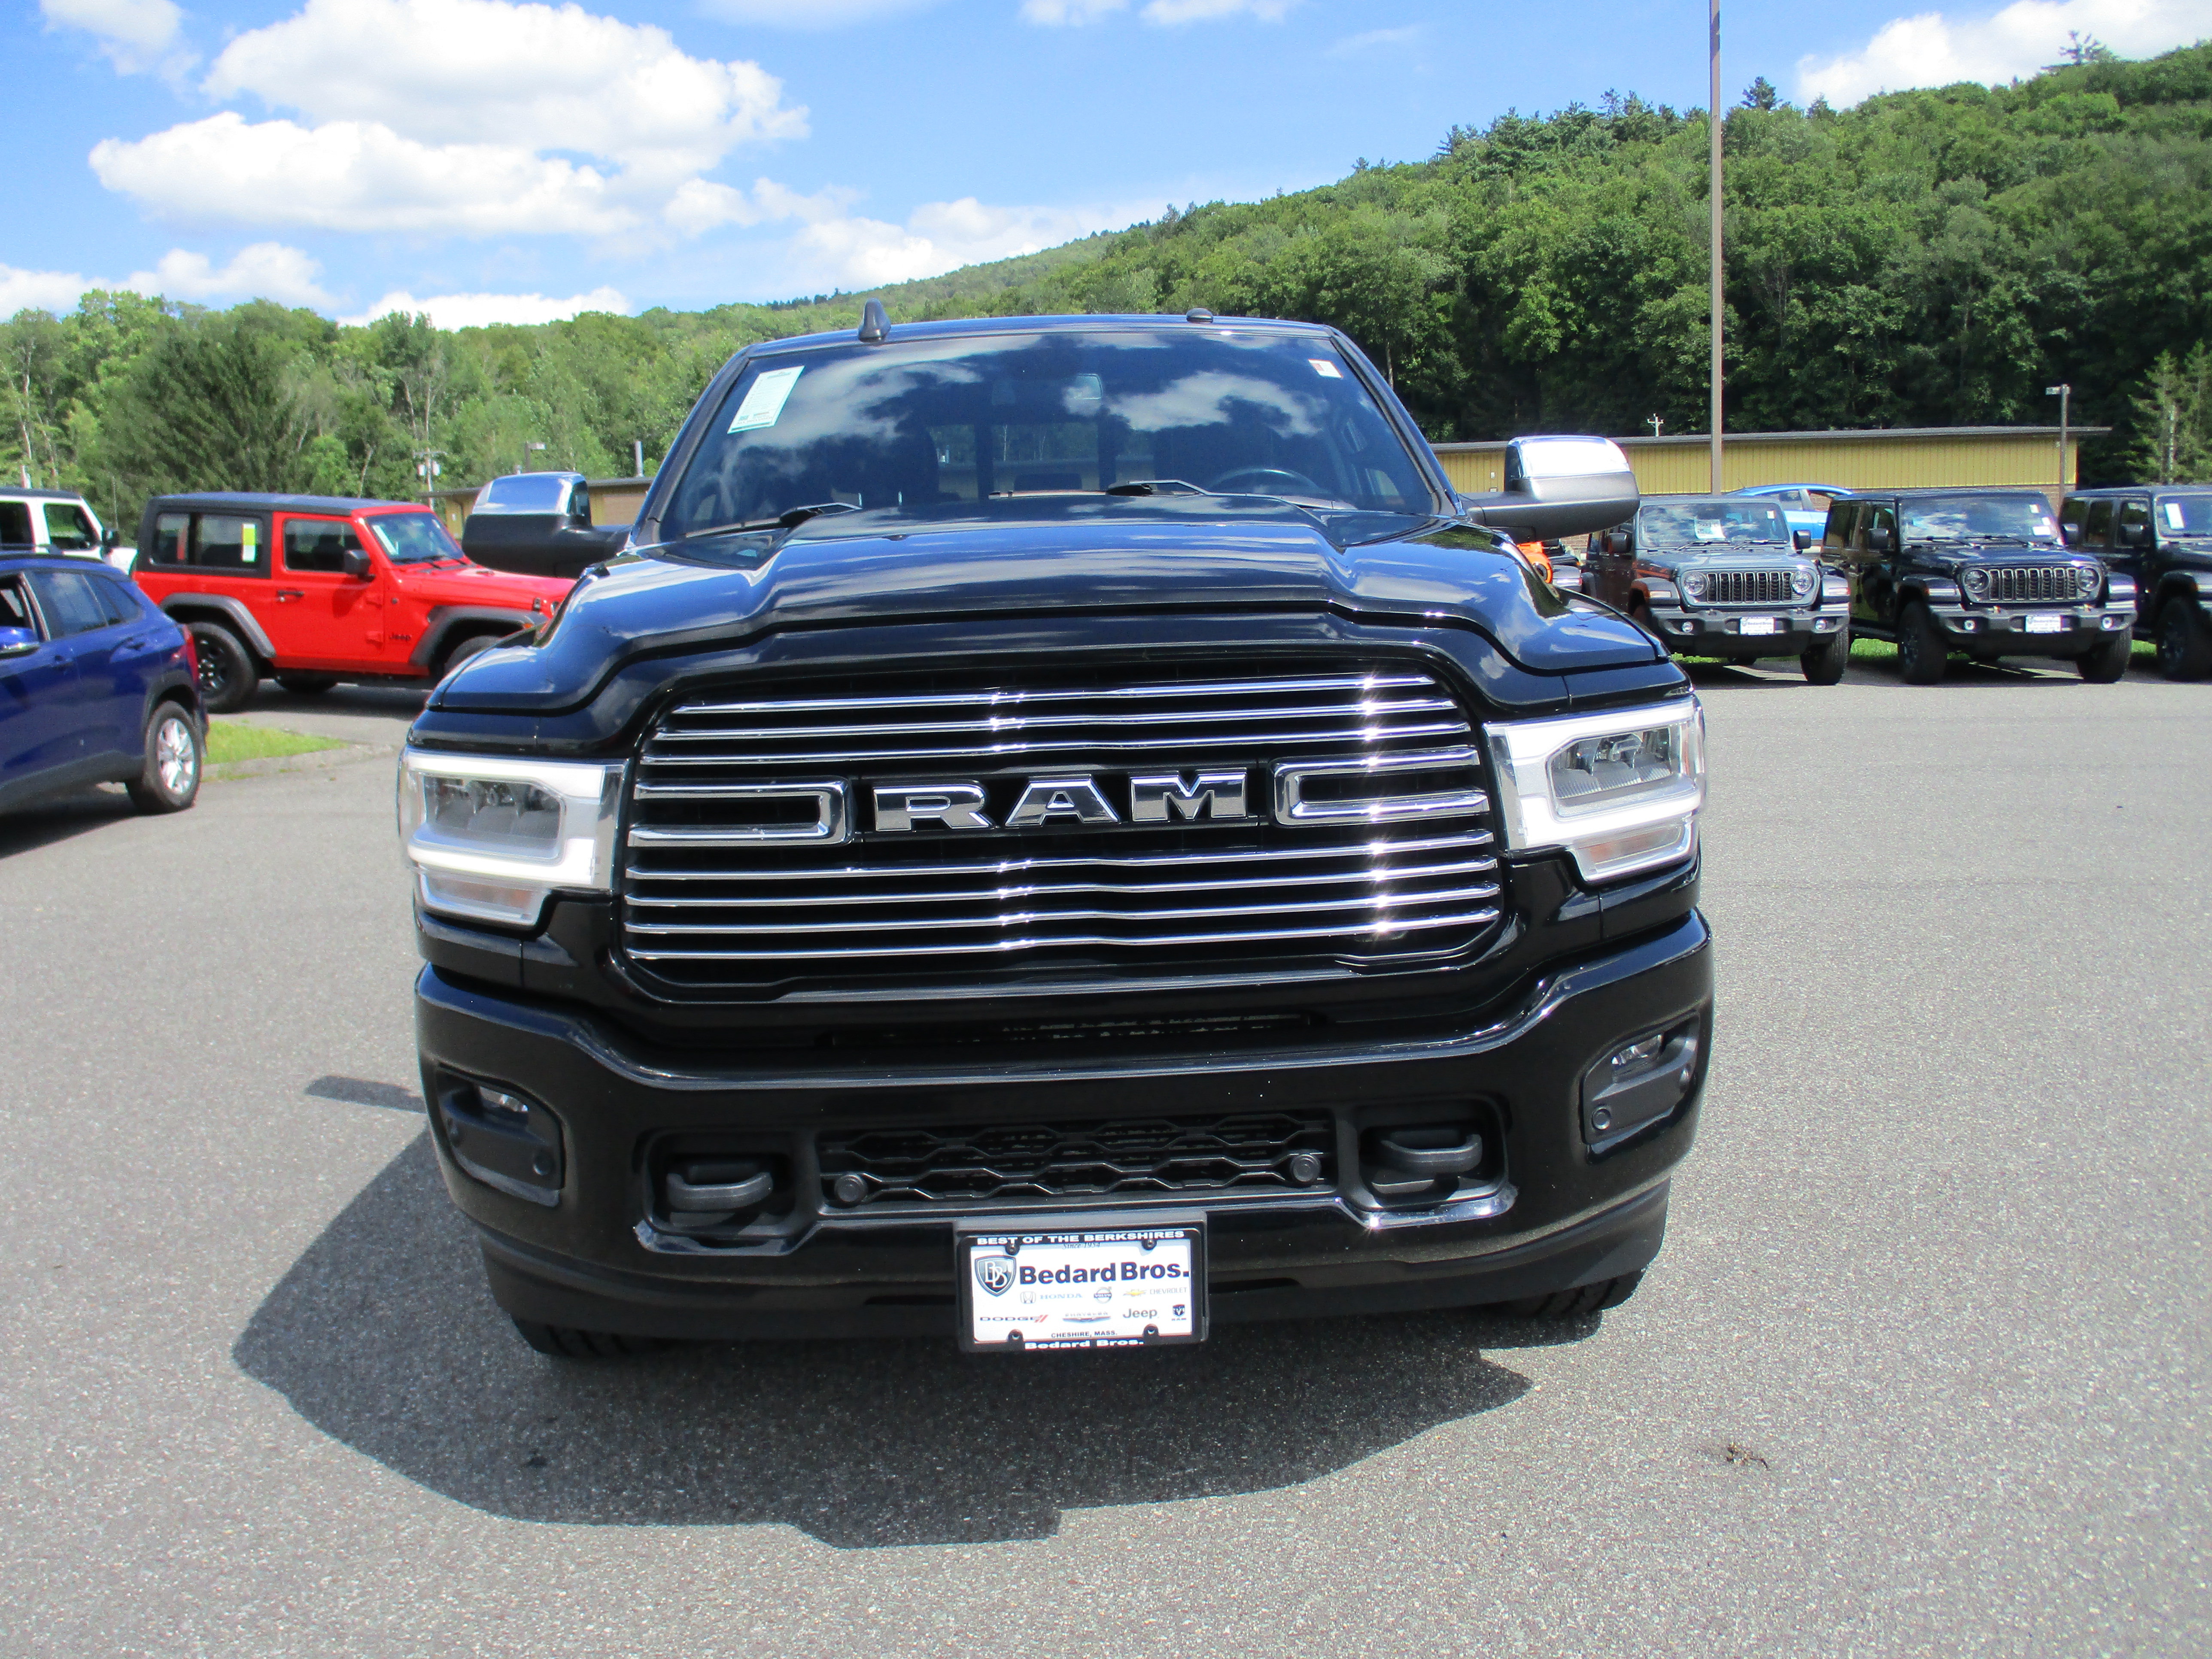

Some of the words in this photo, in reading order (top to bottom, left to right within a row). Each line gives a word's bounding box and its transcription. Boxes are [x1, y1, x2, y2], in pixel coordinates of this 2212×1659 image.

[872, 766, 1248, 832] RAM
[977, 1237, 1018, 1246] BEST
[1022, 1236, 1043, 1244] OF
[1048, 1234, 1079, 1243] THE
[1084, 1231, 1185, 1242] BERKSHIRES
[1020, 1262, 1116, 1285] Bedard
[1121, 1261, 1189, 1281] Bros.
[1122, 1308, 1158, 1319] Jeep
[1025, 1340, 1091, 1349] Bedard
[1096, 1338, 1144, 1347] Bros.
